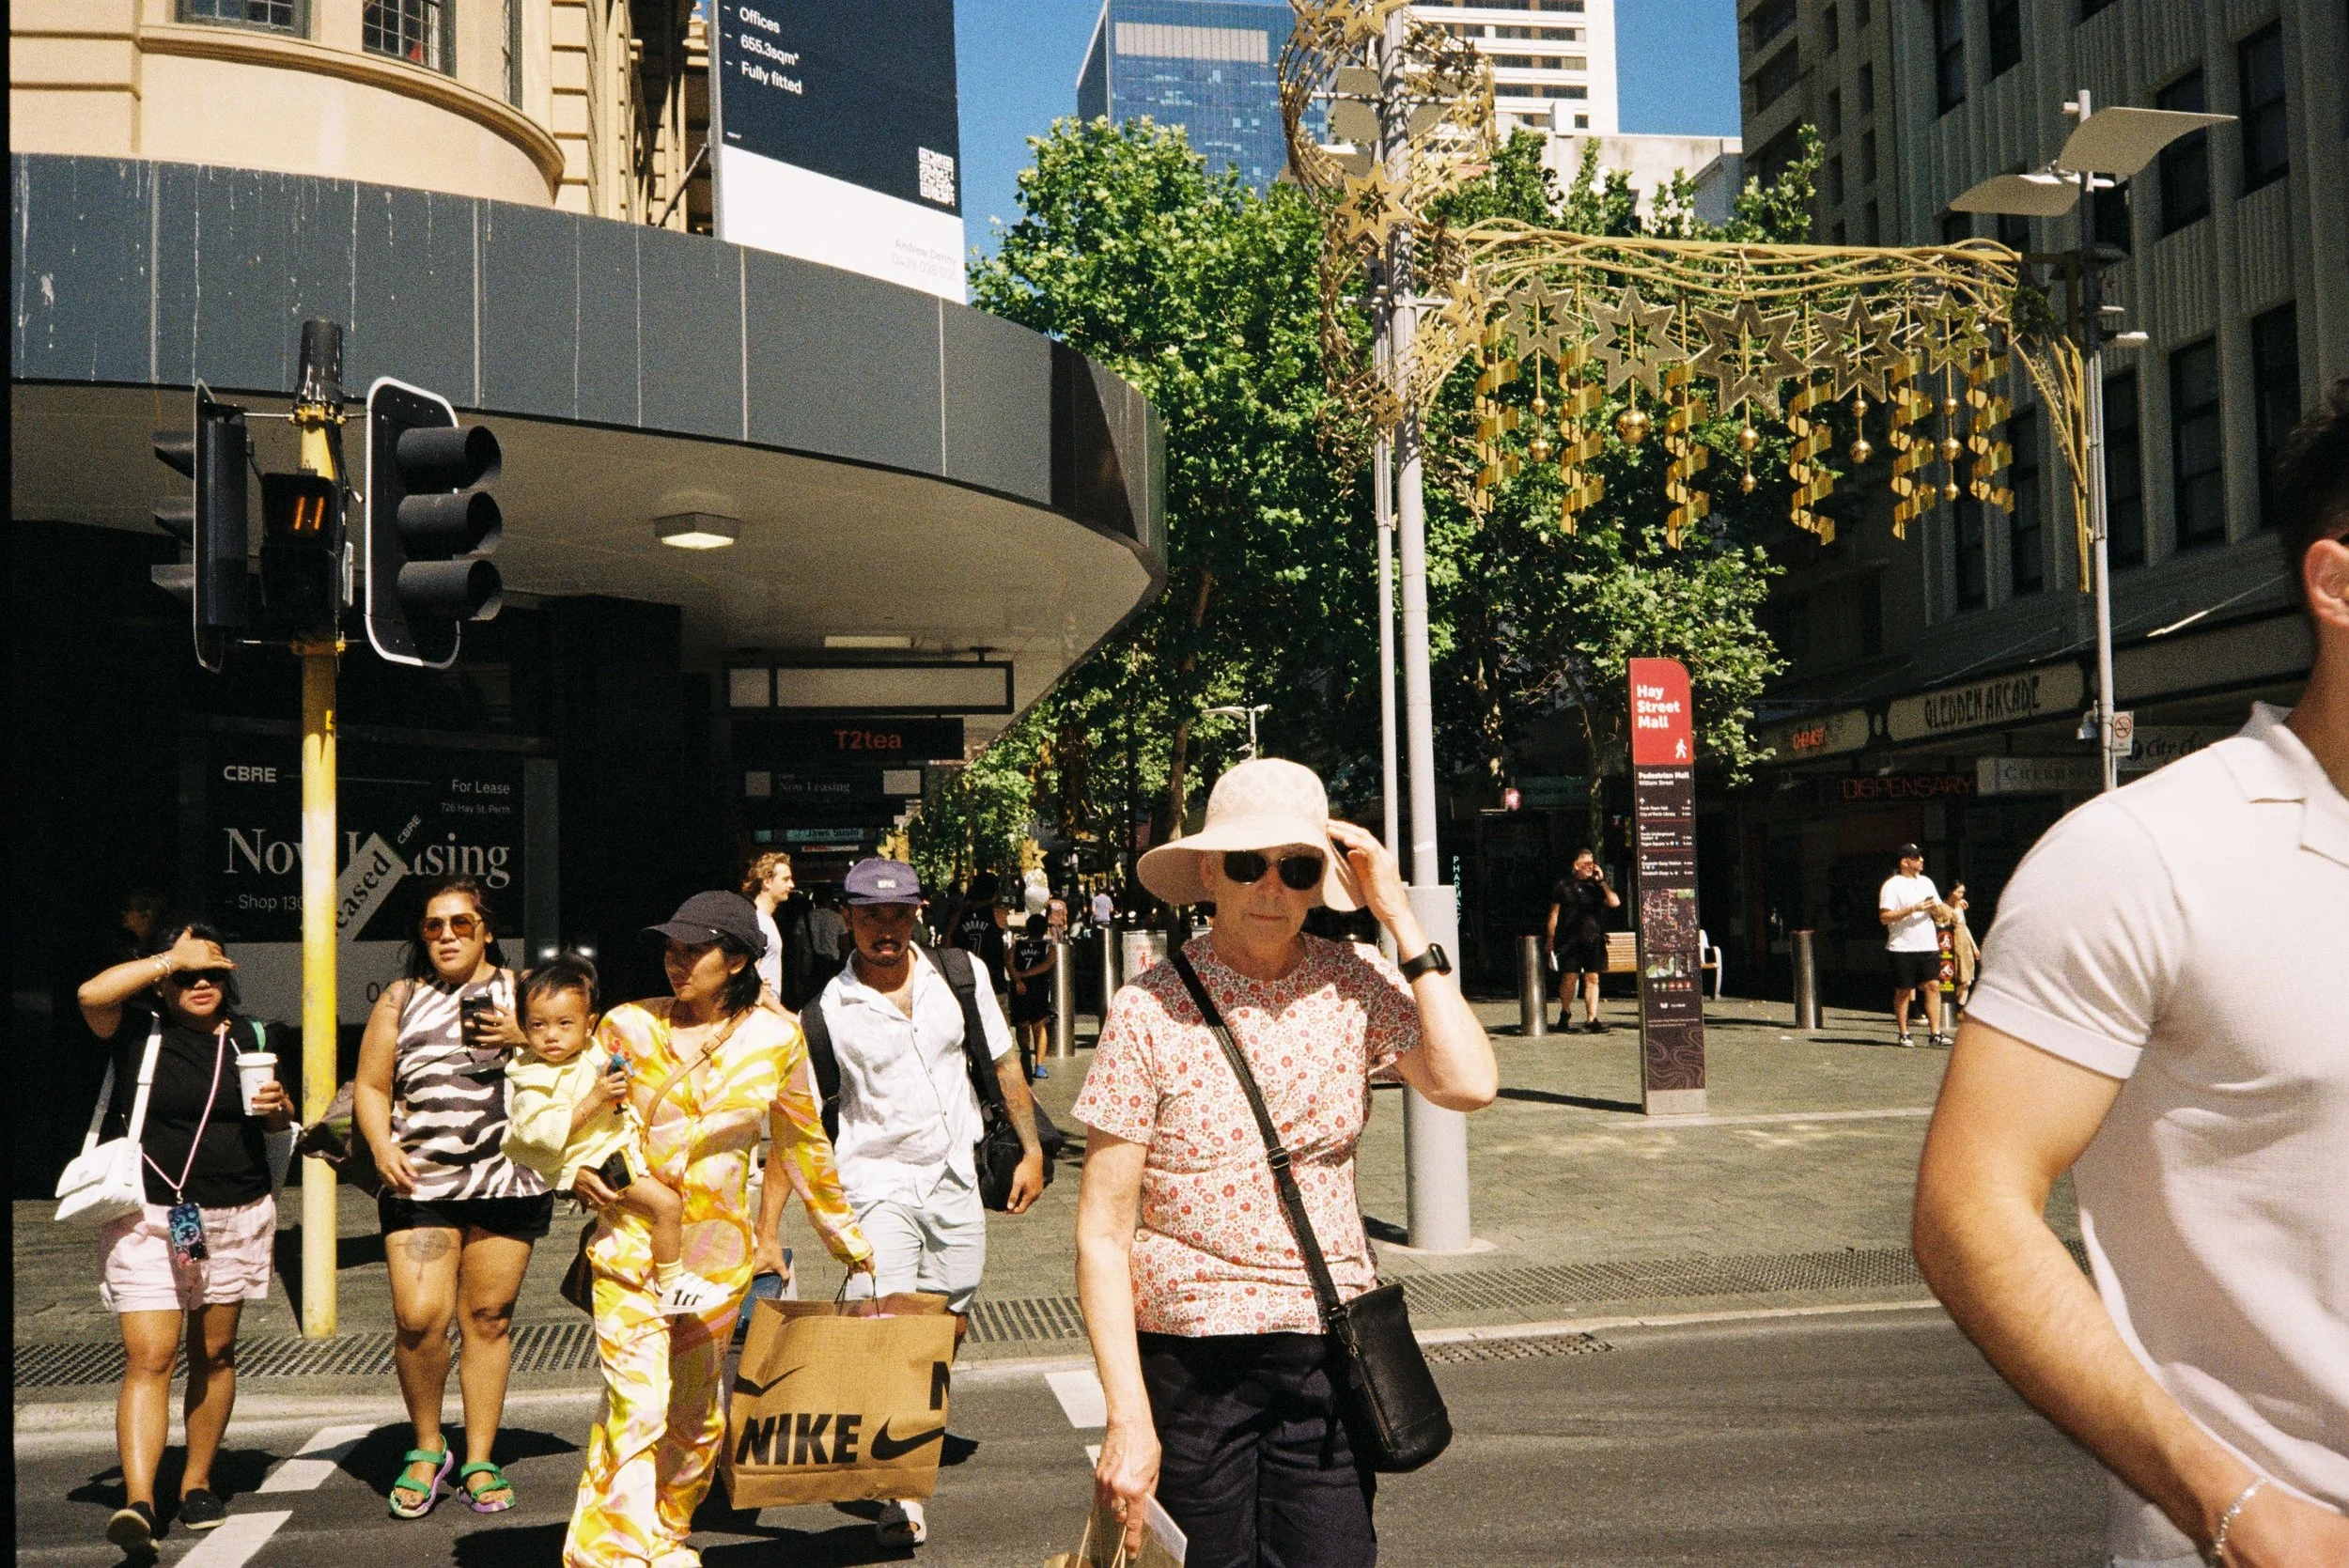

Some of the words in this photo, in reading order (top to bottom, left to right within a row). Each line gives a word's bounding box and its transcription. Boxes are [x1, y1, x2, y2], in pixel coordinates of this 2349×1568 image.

[739, 7, 780, 33] Offices
[741, 62, 769, 85] Fully
[771, 72, 802, 94] fitted
[894, 239, 928, 256] Andrew
[1636, 684, 1664, 701] Hay
[1985, 675, 2041, 720] ARCADE
[1637, 700, 1680, 713] Street
[1638, 715, 1669, 728] Mall
[833, 729, 902, 750] T2tea
[224, 766, 277, 783] CBRE
[452, 779, 472, 793] For
[475, 781, 510, 795] Lease
[397, 814, 421, 845] CBRE
[223, 828, 303, 875] No
[335, 849, 392, 932] eased
[239, 893, 277, 912] Shop
[735, 1413, 863, 1466] NIKE
